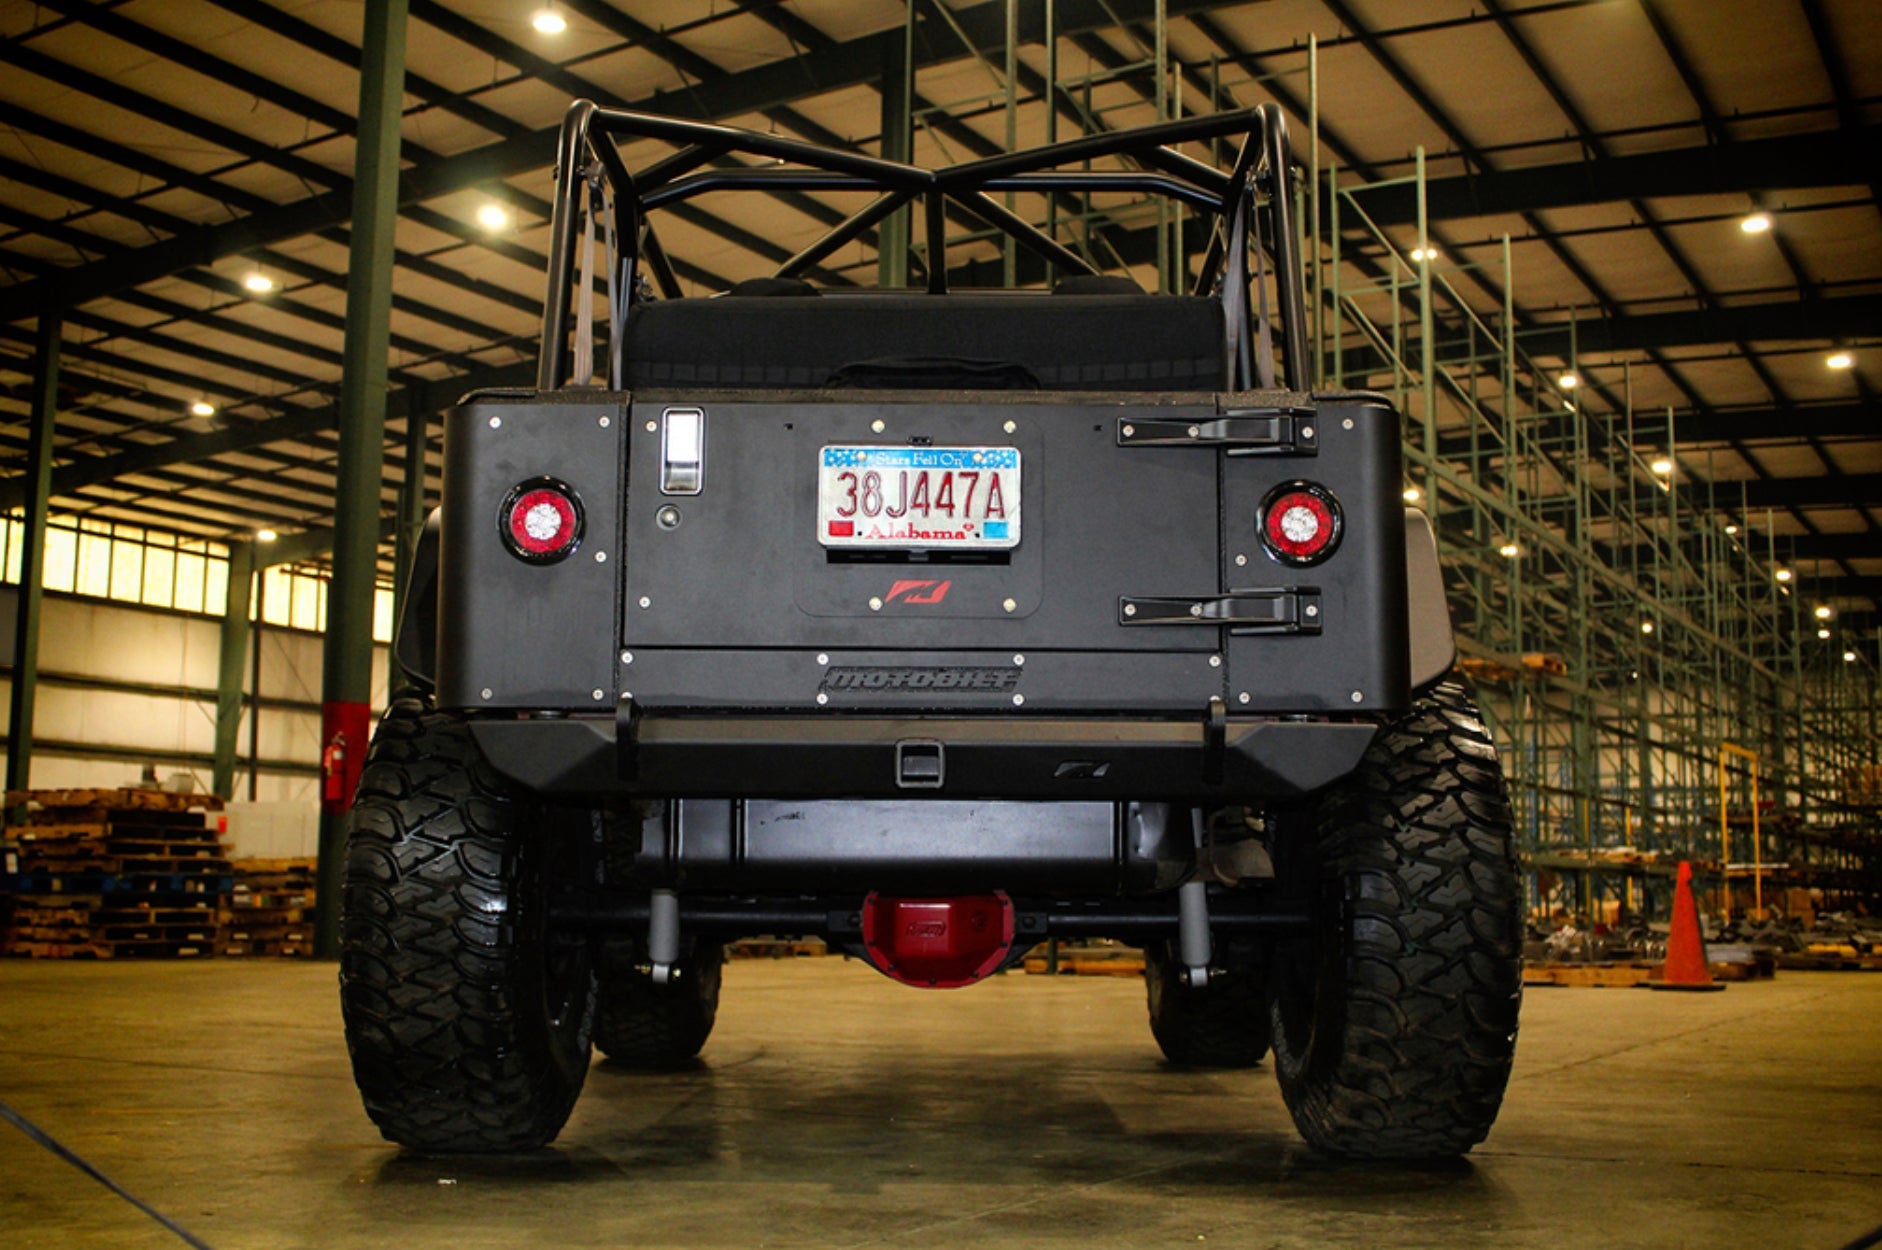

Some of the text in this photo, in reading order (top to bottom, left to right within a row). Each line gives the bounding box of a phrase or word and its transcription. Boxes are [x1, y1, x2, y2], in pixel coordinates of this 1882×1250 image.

[875, 452, 962, 467] Stars Fell On
[837, 470, 1006, 518] 38J447A
[865, 522, 966, 540] Alabama
